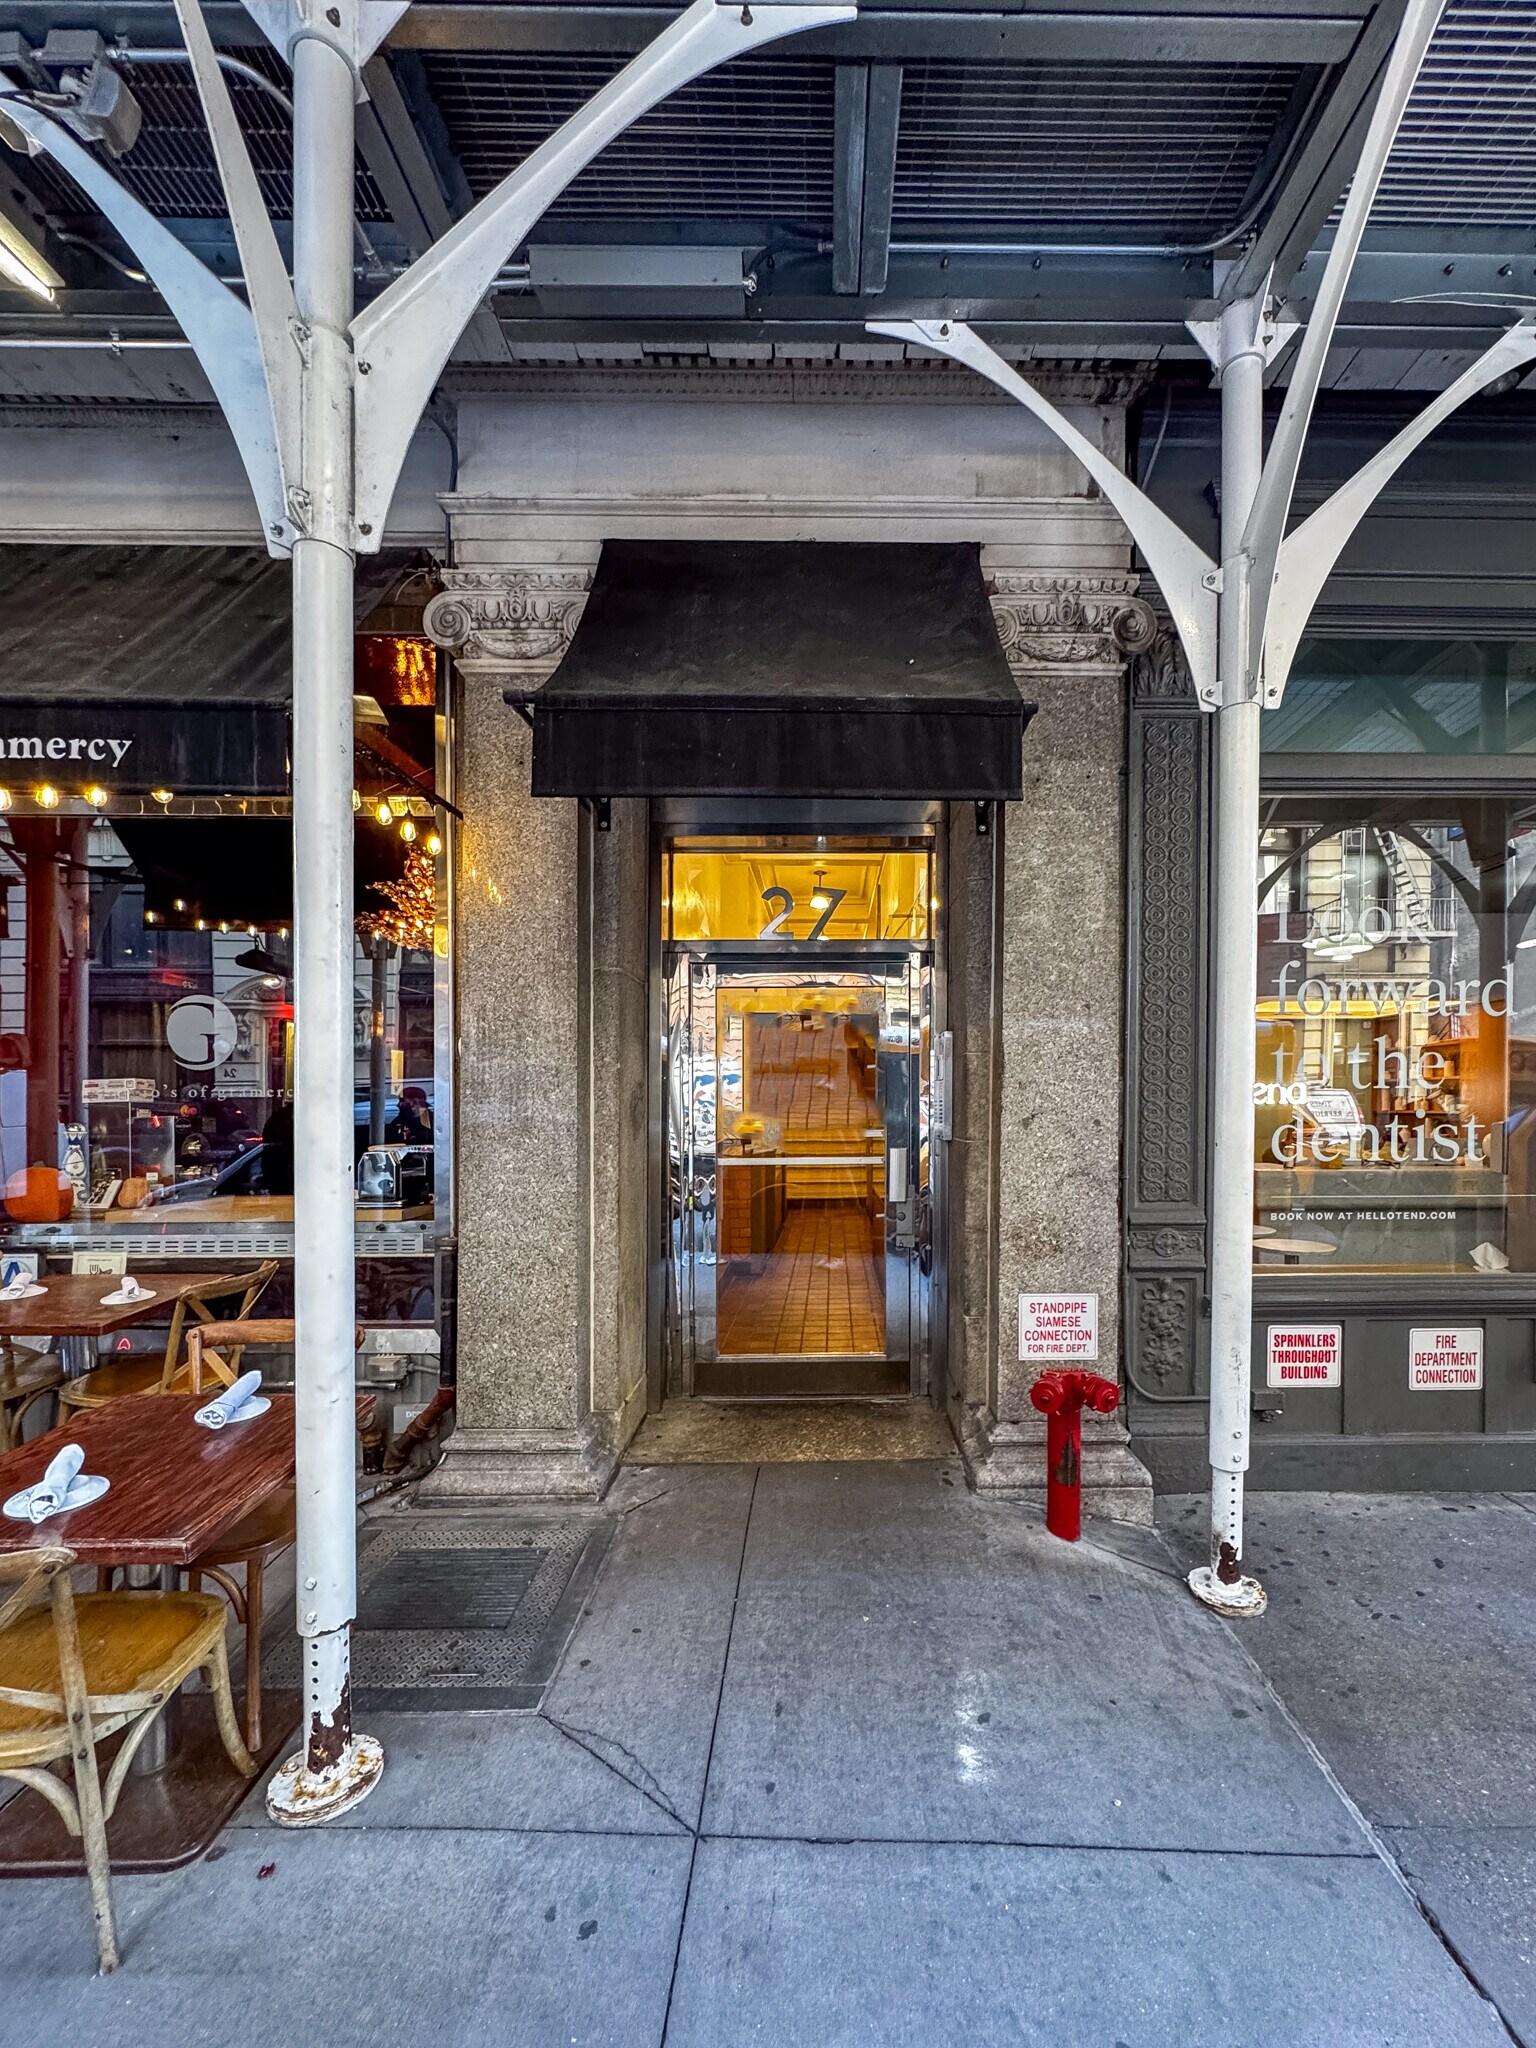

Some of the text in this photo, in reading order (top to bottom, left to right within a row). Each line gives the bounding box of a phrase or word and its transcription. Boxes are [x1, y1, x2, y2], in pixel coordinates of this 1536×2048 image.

[761, 886, 848, 940] 27
[1271, 888, 1435, 945] Look
[1271, 960, 1518, 1017] forward
[1348, 1035, 1446, 1090] the
[188, 1085, 209, 1098] of
[1271, 1107, 1487, 1162] dentist
[1270, 1211, 1456, 1221] BOOK NOW AT HELLOTEND.COM
[1029, 1302, 1087, 1313] STANDPIPE
[1035, 1316, 1081, 1327] SIAMESE
[1024, 1330, 1092, 1341] CONNECTION
[1274, 1334, 1336, 1347] SPRINKLERS
[1435, 1335, 1457, 1349] FIRE
[1027, 1344, 1089, 1353] FOR FIRE DEPT.
[1272, 1350, 1337, 1363] THROUGHOUT
[1414, 1352, 1478, 1366] DEPARTMENT
[1281, 1365, 1328, 1379] BUILDING
[1415, 1369, 1476, 1384] CONNECTION
